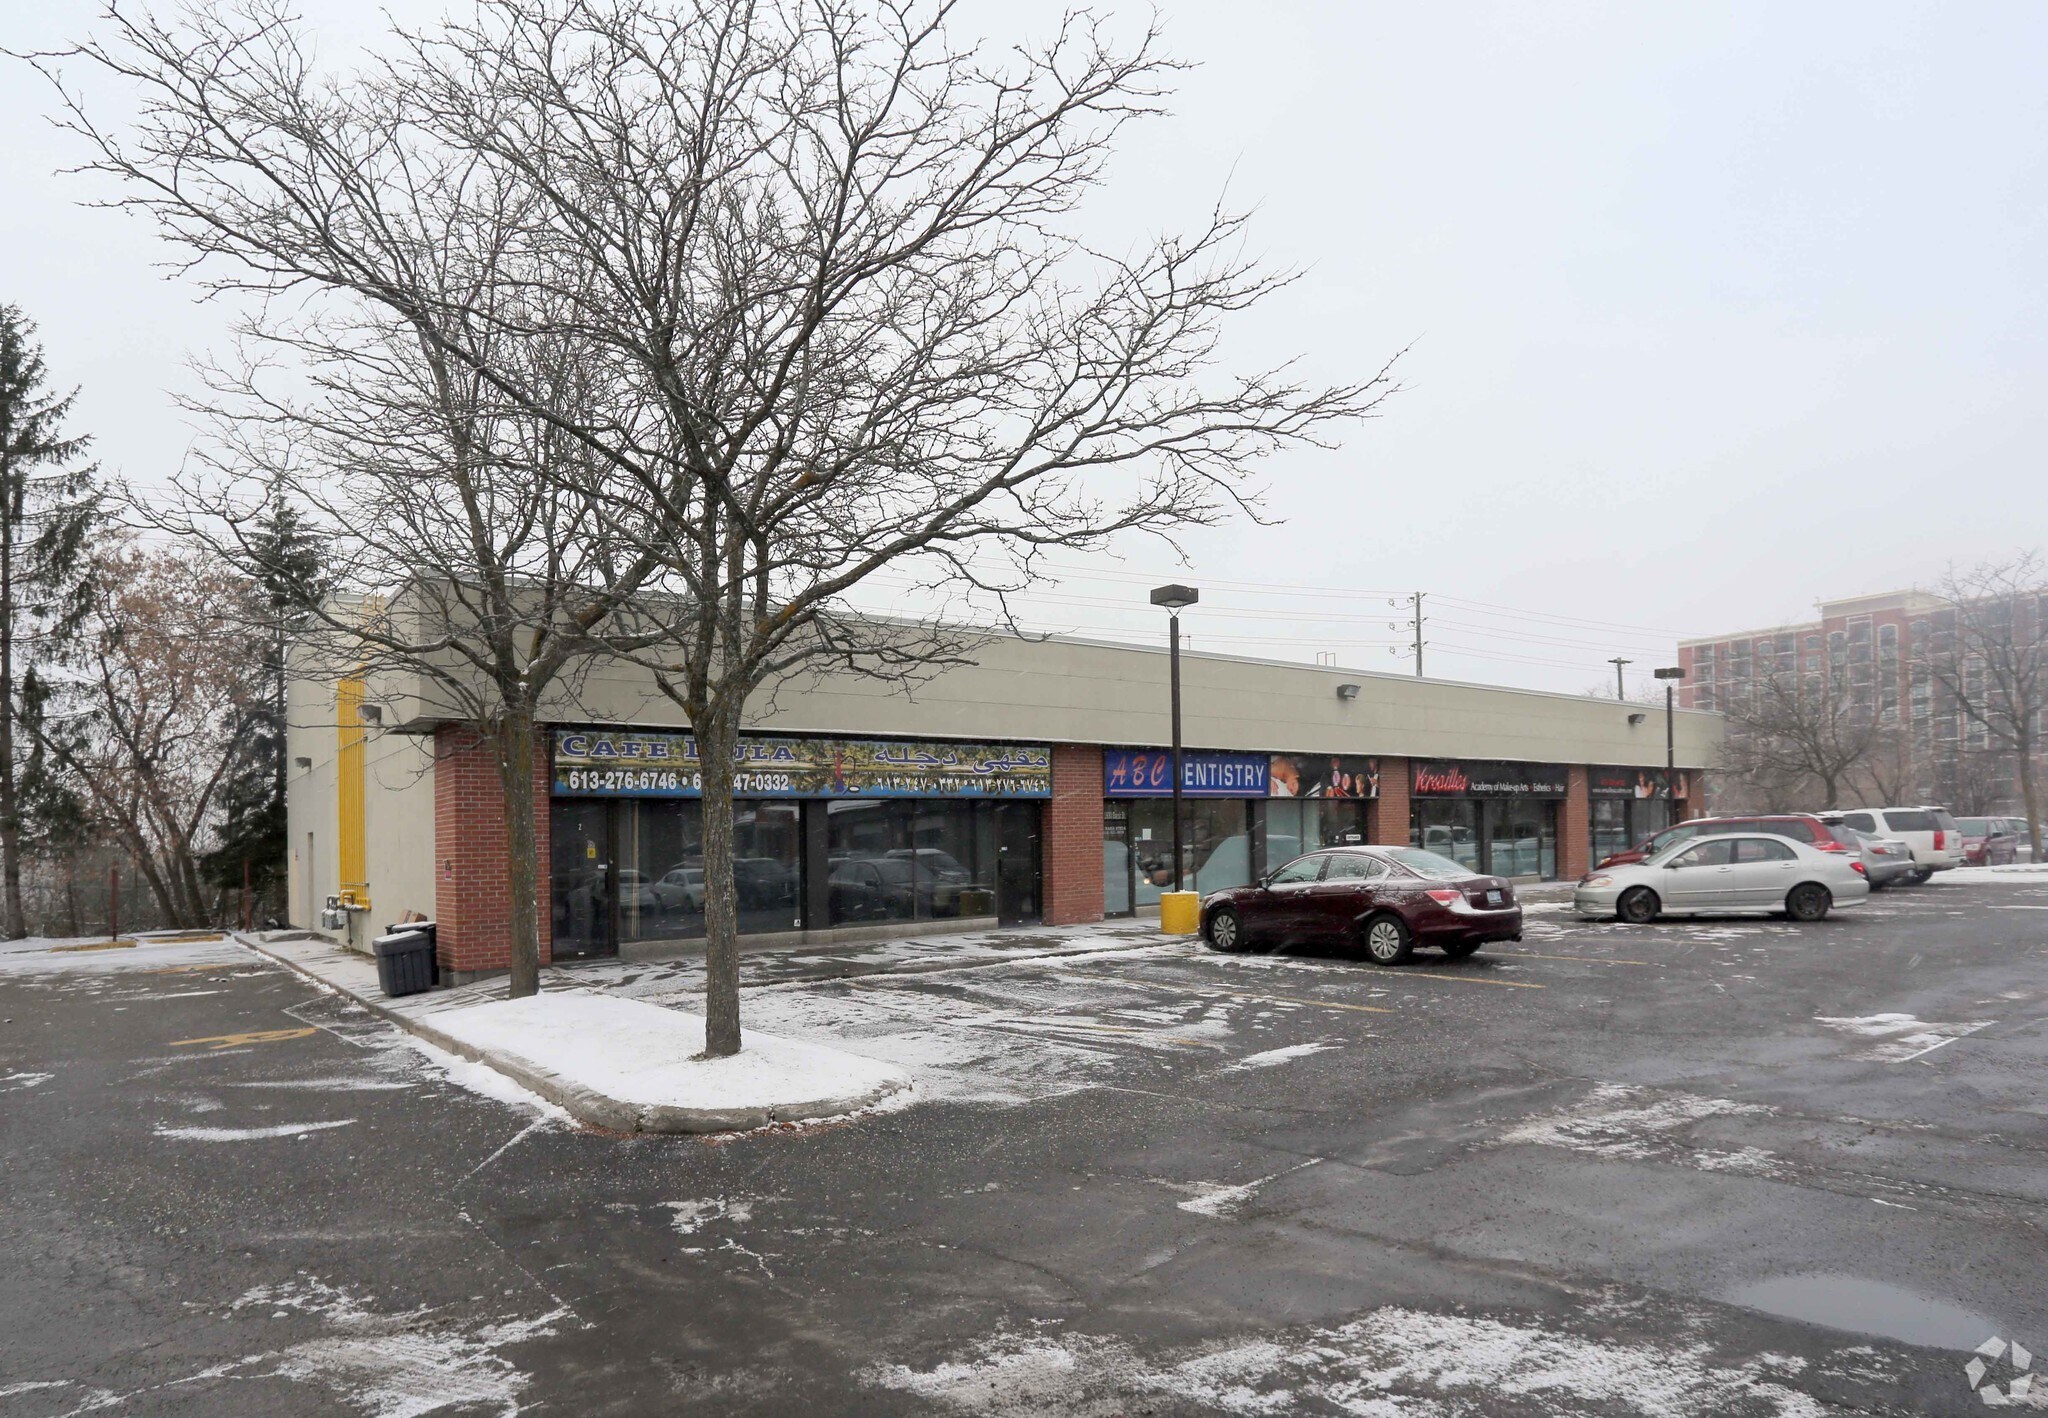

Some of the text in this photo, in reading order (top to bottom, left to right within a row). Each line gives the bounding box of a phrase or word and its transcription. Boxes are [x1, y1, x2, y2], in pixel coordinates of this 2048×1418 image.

[562, 735, 668, 758] CAFE
[569, 771, 789, 790] 613-276-6746 647-0332
[1181, 762, 1265, 786] ENTISTRY
[1471, 782, 1492, 793] Academy
[1494, 782, 1500, 791] of
